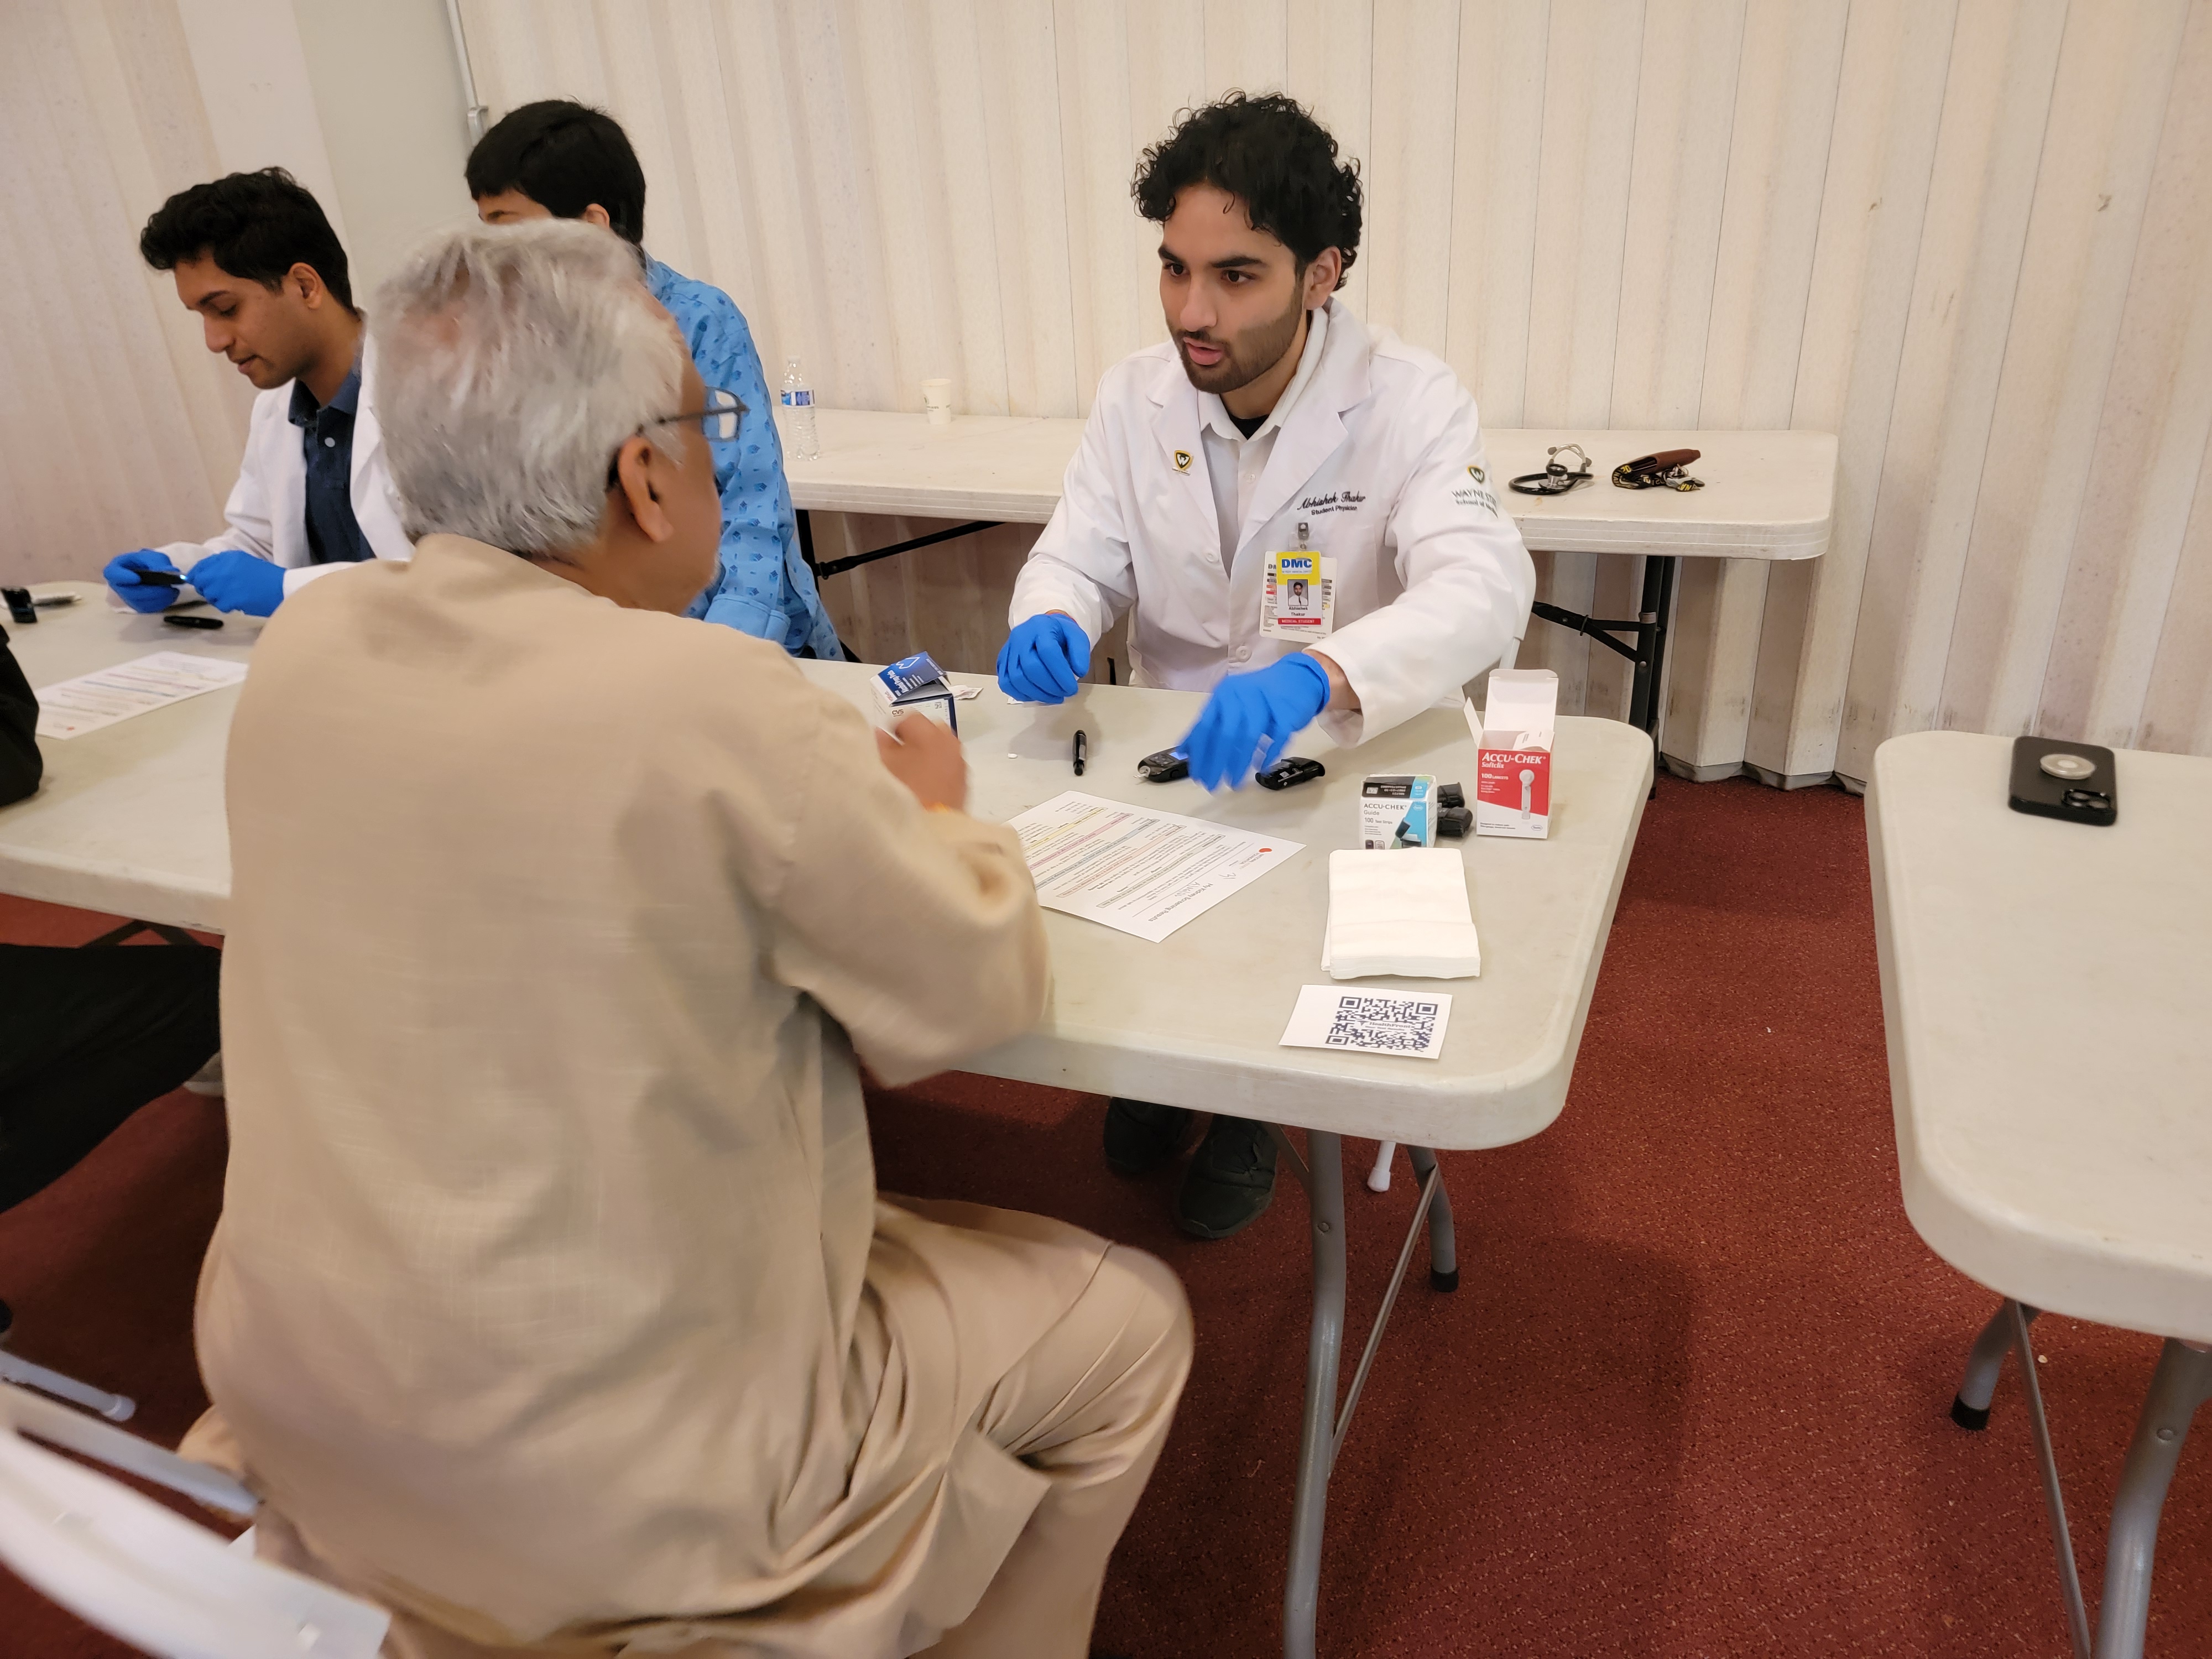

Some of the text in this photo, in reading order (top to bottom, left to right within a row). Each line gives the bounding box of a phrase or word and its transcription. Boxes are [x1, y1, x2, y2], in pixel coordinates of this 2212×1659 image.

[1451, 489, 1484, 499] WAYNE
[1311, 506, 1334, 515] Student
[1281, 559, 1312, 568] DMC
